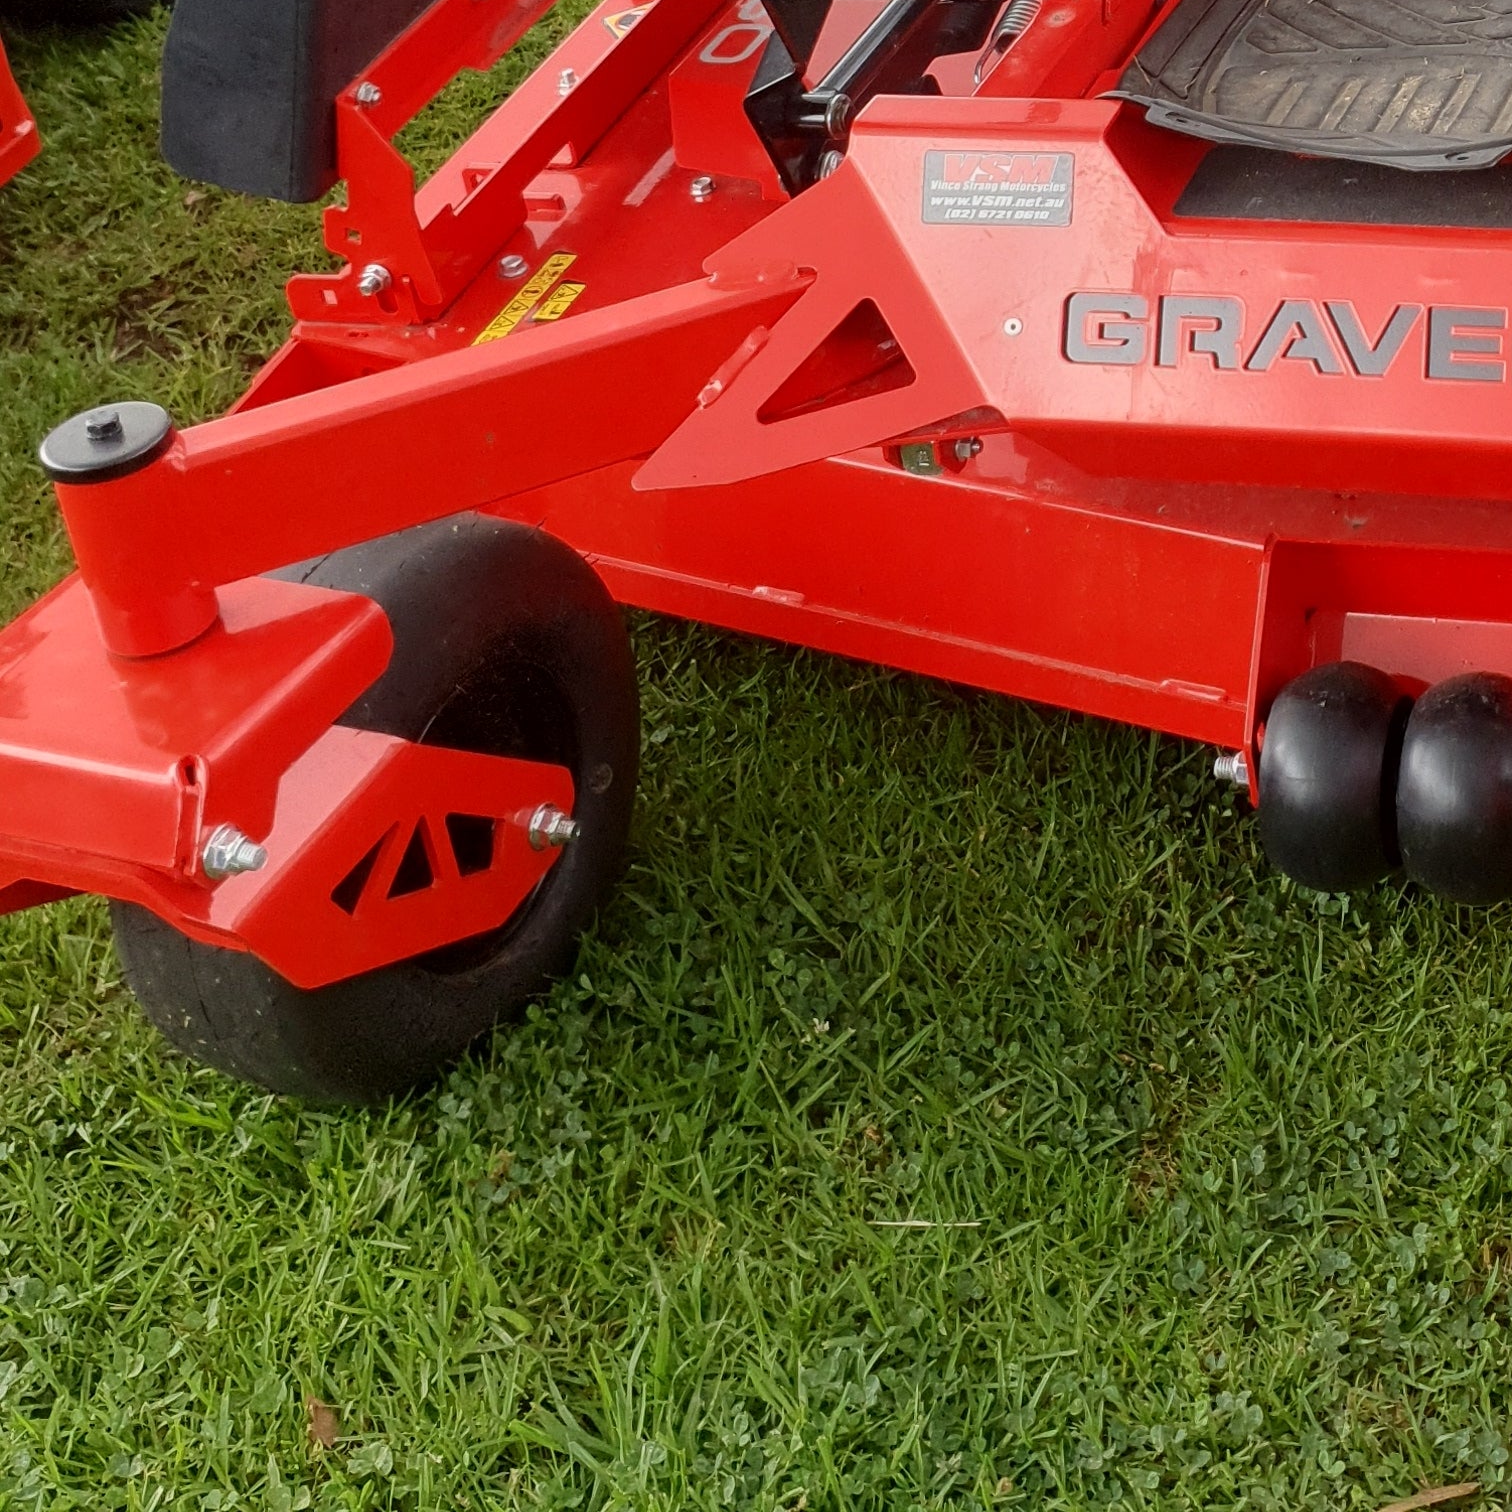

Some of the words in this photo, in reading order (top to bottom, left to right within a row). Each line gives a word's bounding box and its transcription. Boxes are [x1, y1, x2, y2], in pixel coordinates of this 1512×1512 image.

[944, 154, 1058, 184] VSM
[930, 180, 961, 191] Vince
[963, 181, 998, 192] Strang
[1000, 182, 1066, 193] Motorcycles
[930, 194, 1065, 208] www.VSM.net.au
